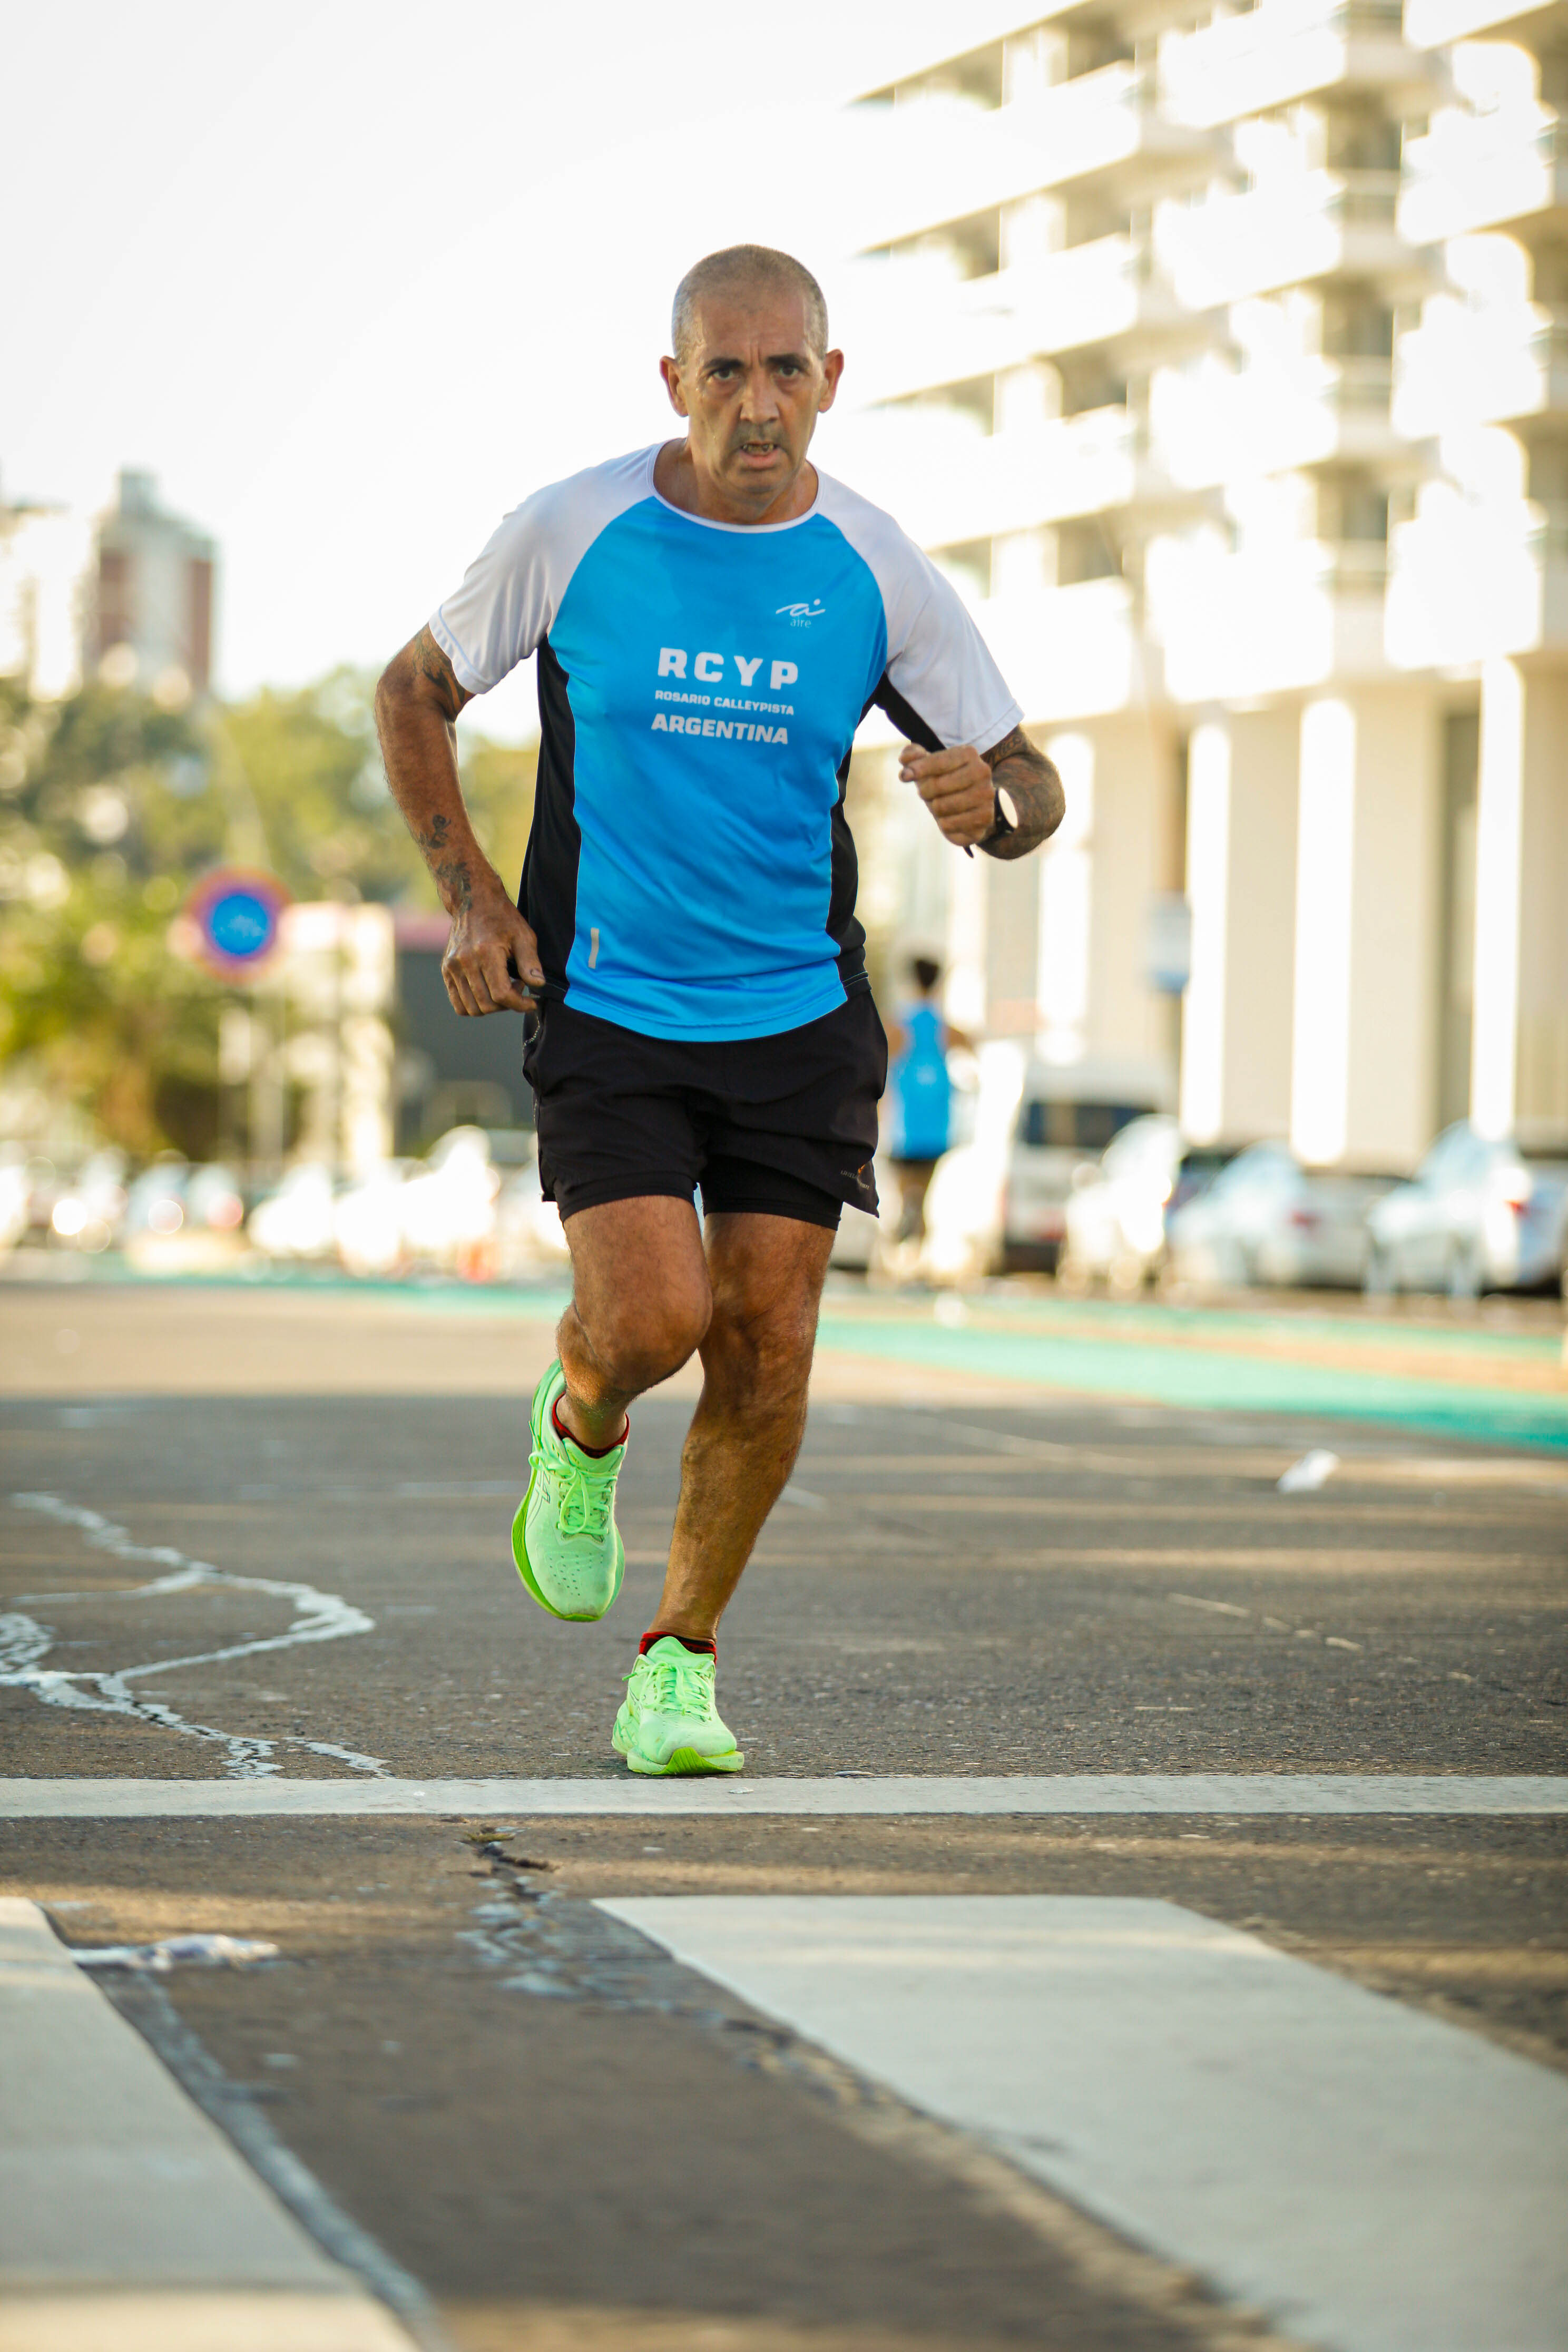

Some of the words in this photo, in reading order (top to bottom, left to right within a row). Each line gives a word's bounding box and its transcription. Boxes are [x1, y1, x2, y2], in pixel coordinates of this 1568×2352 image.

[658, 648, 798, 690] RCYP
[655, 690, 711, 705] ROSARIO
[714, 697, 794, 715] CALLEYPISTA
[651, 713, 788, 744] ARGENTINA
